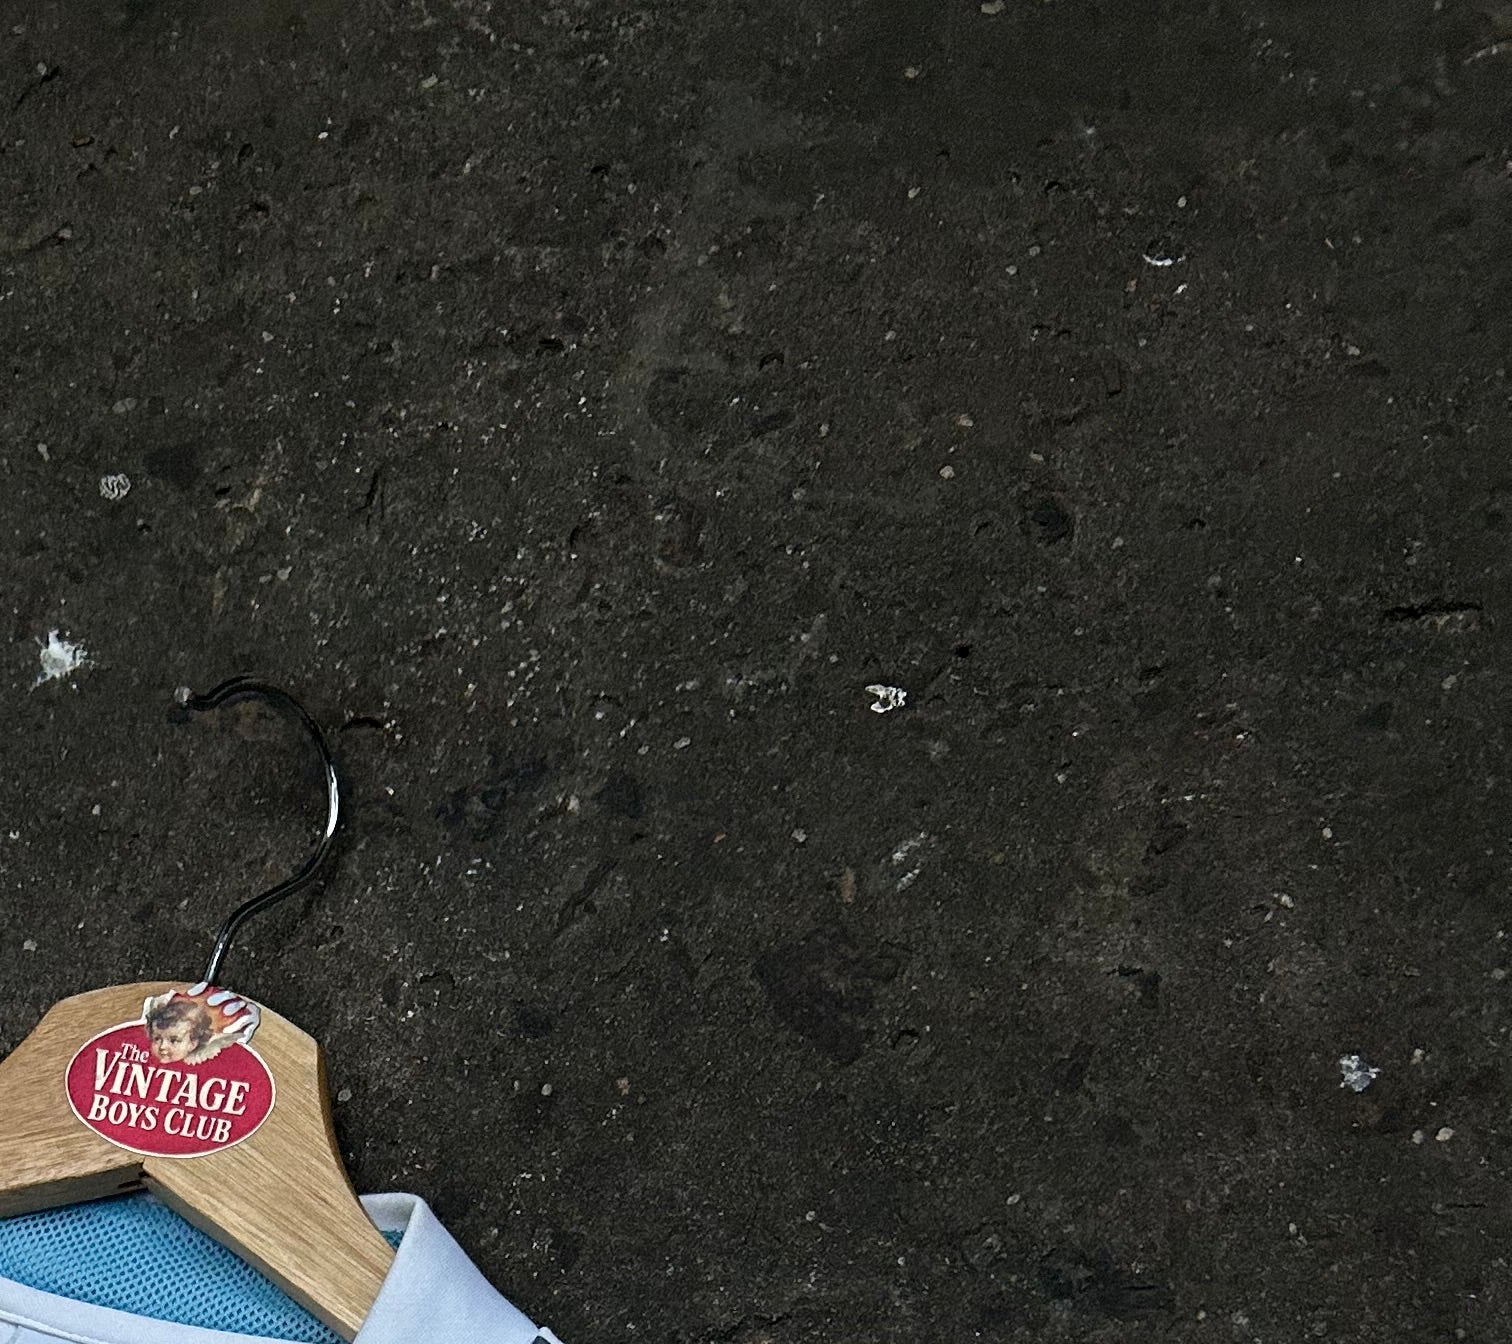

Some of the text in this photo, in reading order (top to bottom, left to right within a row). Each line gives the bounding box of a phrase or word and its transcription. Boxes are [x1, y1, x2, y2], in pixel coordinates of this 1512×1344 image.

[120, 1042, 150, 1063] The
[94, 1048, 251, 1117] VINTAGE
[88, 1095, 233, 1144] BOYS CLUB
